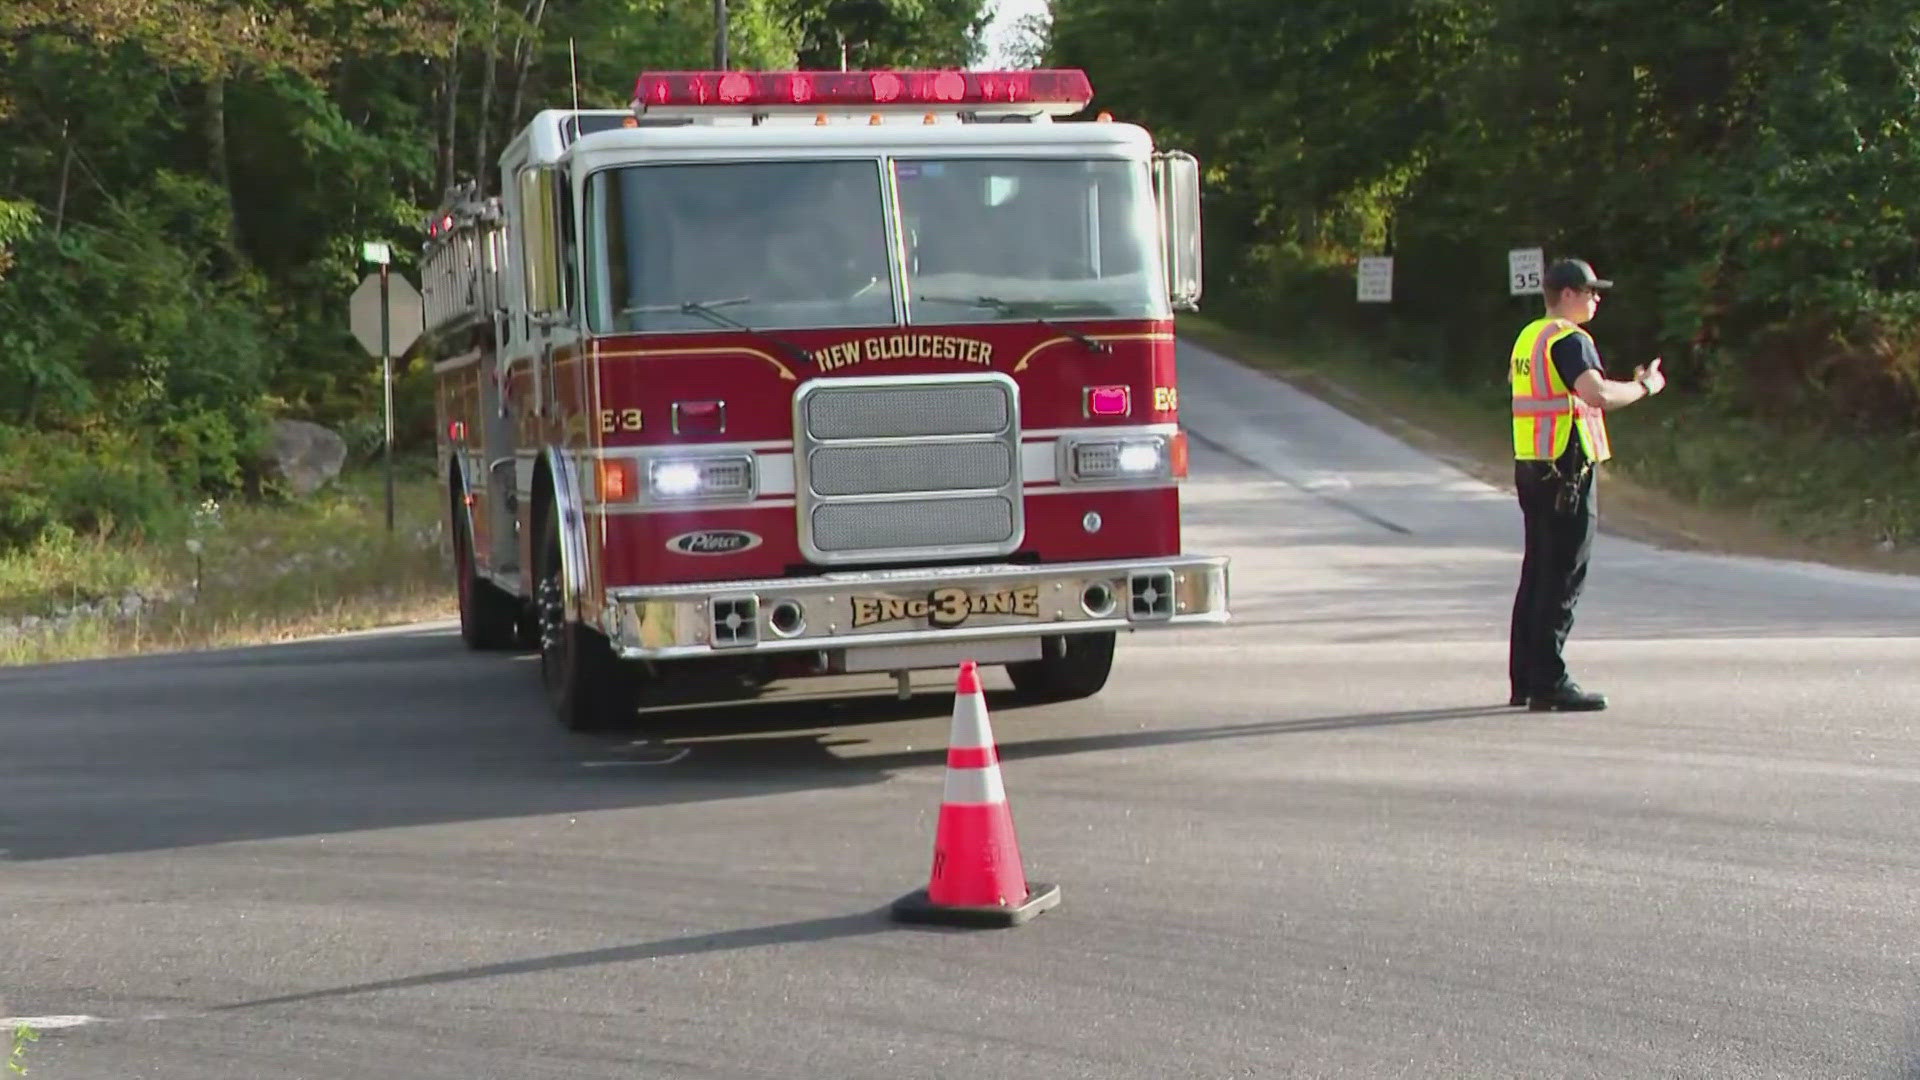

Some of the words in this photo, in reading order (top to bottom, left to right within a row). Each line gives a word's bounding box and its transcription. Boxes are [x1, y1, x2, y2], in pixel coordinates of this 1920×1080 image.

[1514, 272, 1540, 290] 35
[815, 340, 861, 373] NEW
[865, 334, 993, 366] GLOUCESTER
[687, 532, 740, 552] Pierce
